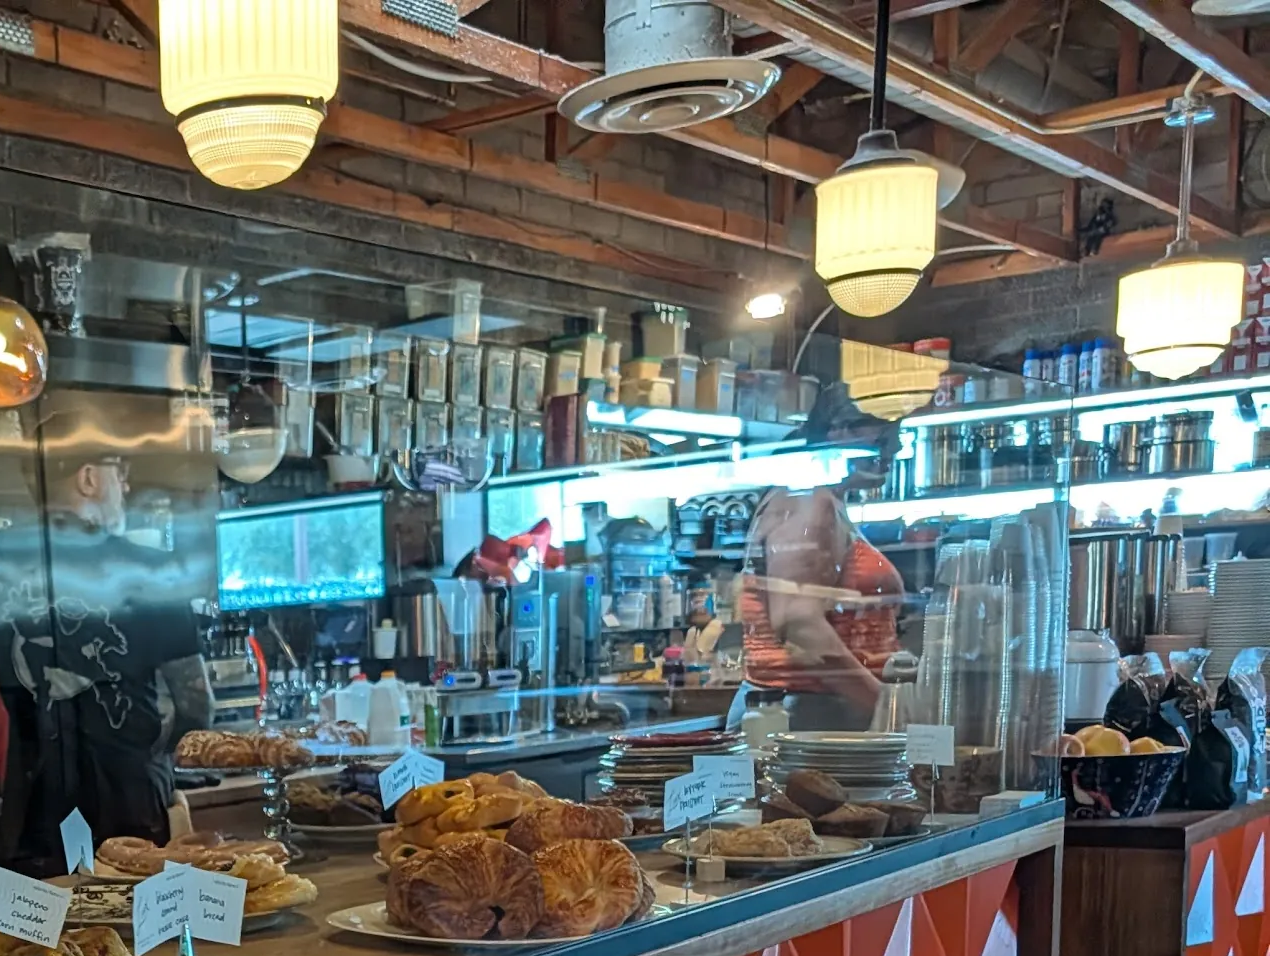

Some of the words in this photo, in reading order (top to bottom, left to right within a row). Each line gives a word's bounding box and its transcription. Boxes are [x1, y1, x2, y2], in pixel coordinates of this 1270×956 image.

[11, 909, 47, 925] cheddar
[203, 908, 226, 922] bread
[19, 927, 51, 943] muffin
